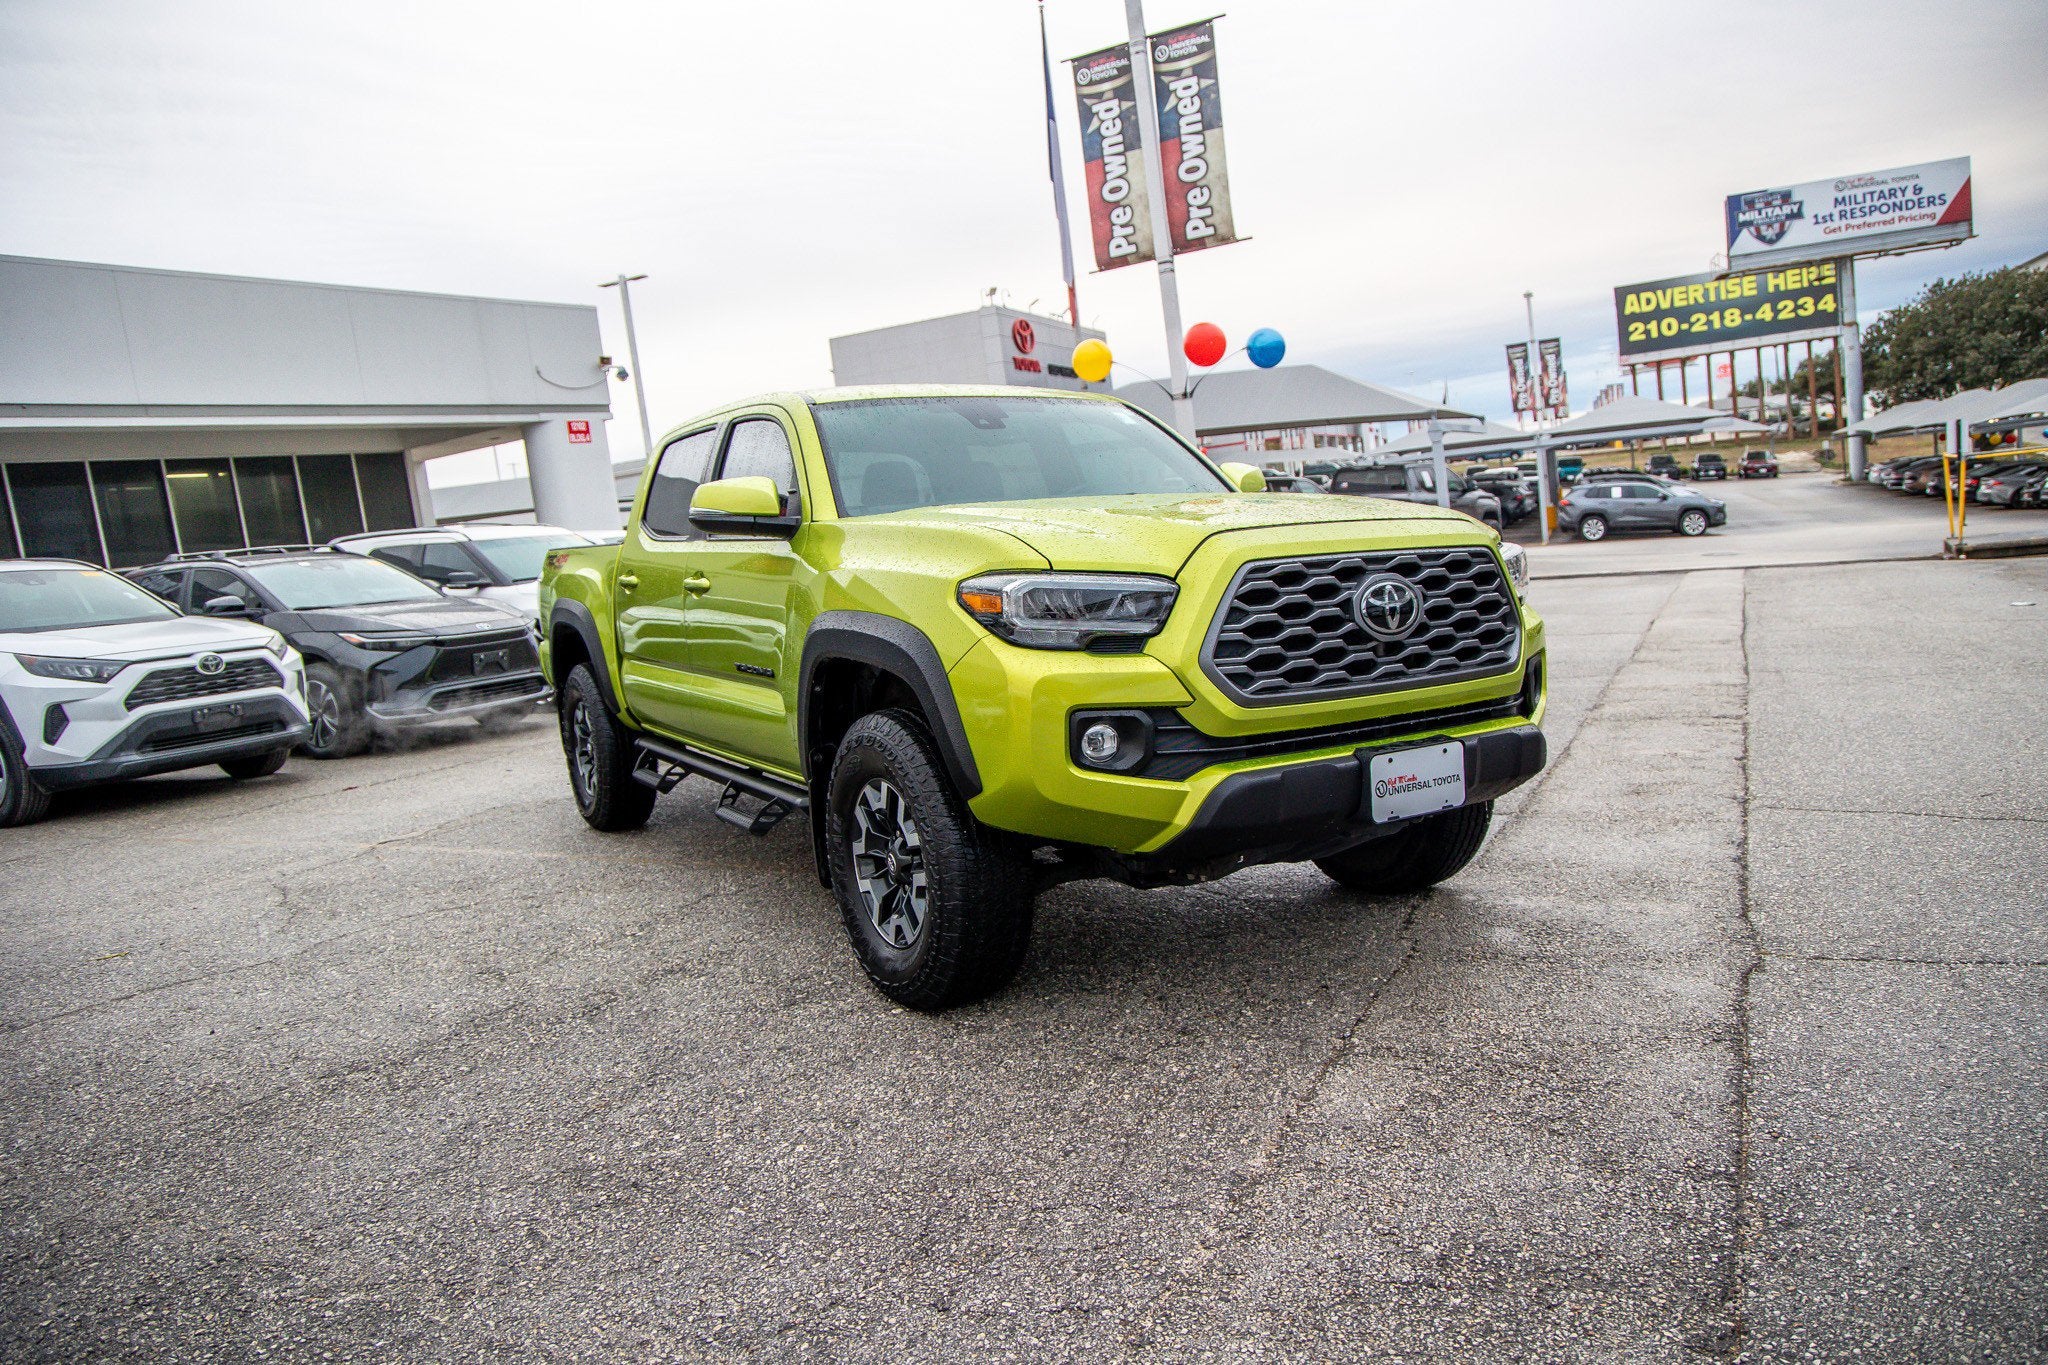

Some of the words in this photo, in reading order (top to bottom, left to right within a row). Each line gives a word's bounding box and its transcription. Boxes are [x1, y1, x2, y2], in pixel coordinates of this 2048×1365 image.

[1168, 34, 1211, 51] UNIVERSAL
[1169, 45, 1198, 59] TOYOTA
[1090, 57, 1130, 74] UNIVERSAL
[1091, 68, 1119, 81] TOYOTA
[1168, 75, 1208, 183] Owned
[1092, 97, 1130, 203] Owned
[1833, 184, 1909, 208] MILITARY
[1913, 183, 1924, 195] &
[1185, 186, 1216, 241] Pre
[1737, 202, 1800, 224] MILITARY
[1813, 211, 1835, 225] 1st
[1839, 193, 1948, 221] RESPONDERS
[1108, 205, 1137, 259] Pre
[1823, 225, 1842, 235] Get
[1845, 217, 1895, 232] Preferred
[1898, 211, 1937, 224] Pricing
[1623, 275, 1758, 316] ADVERTISE
[1766, 262, 1837, 294] HERE
[1627, 293, 1837, 343] 210-218-4234
[1388, 780, 1432, 796] UNIVERSAL
[1433, 774, 1461, 787] TOYOTA
